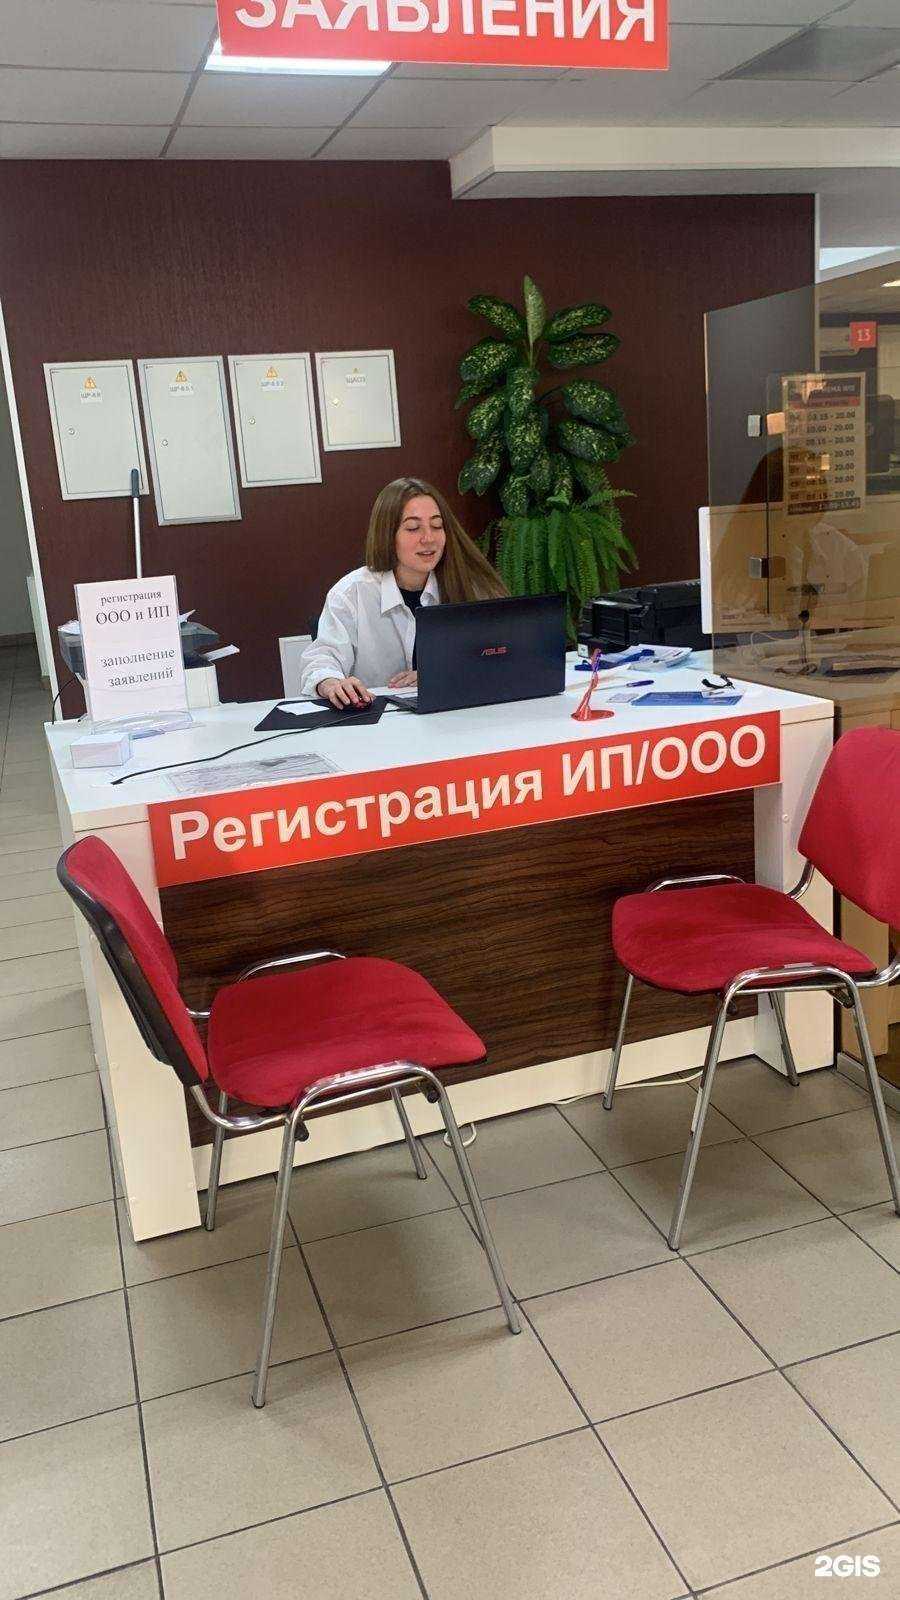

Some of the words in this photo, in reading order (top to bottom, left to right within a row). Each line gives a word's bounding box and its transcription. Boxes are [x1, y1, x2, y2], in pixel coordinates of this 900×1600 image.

[857, 329, 872, 342] 13
[100, 591, 162, 606] регистрация
[95, 609, 131, 625] ООО
[135, 612, 144, 621] и
[147, 605, 171, 619] ИП
[100, 649, 176, 668] заполнение
[107, 667, 174, 687] заявлений
[169, 768, 543, 861] Регистрация
[562, 724, 767, 798] ИП/ООО
